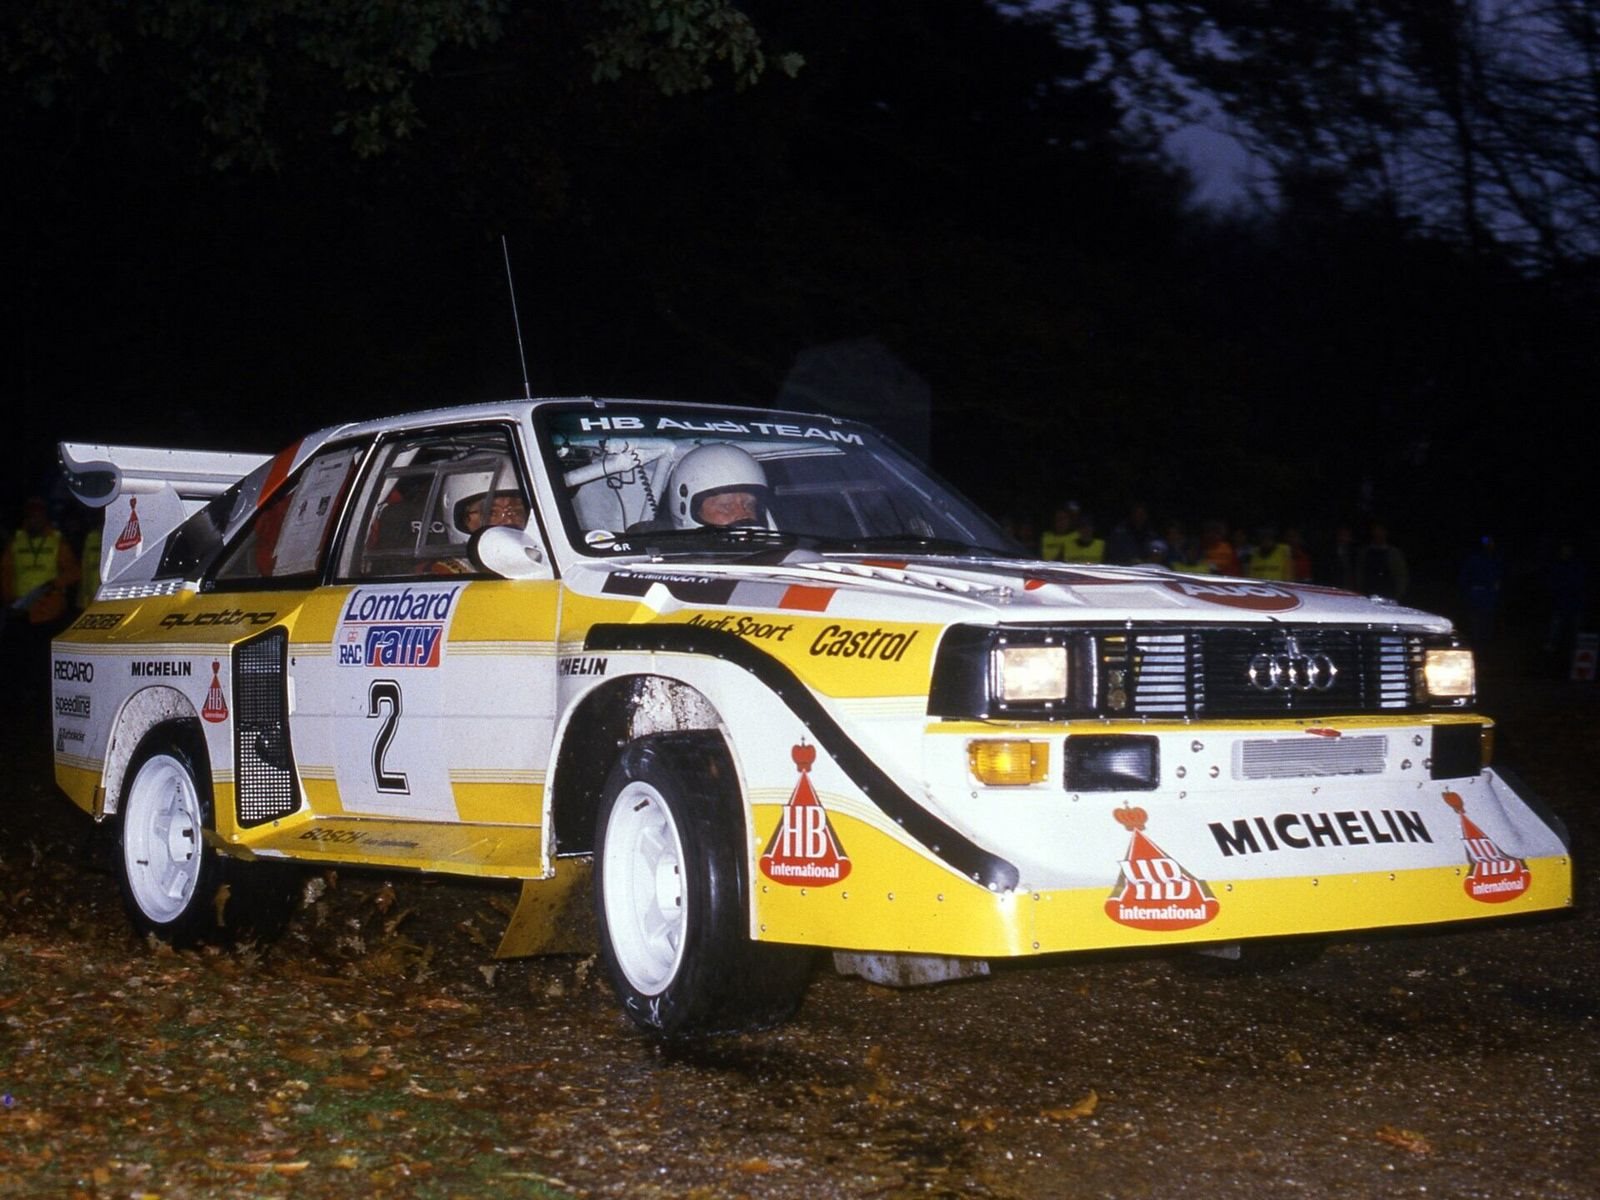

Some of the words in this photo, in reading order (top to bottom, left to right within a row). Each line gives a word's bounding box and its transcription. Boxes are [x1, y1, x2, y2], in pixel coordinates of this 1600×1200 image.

[581, 416, 645, 432] HB
[750, 422, 865, 446] TEAM
[344, 586, 460, 621] Lombard
[159, 608, 277, 631] quattro
[730, 616, 795, 641] Sport
[340, 644, 363, 665] RAC
[366, 627, 443, 666] rally
[809, 624, 919, 662] Castrol
[54, 661, 94, 683] RECARO
[131, 661, 192, 677] MICHELIN
[55, 695, 91, 715] speedline
[208, 687, 223, 710] HB
[366, 679, 410, 795] 2
[299, 827, 367, 844] BOSCH
[783, 805, 827, 858] HB
[1208, 810, 1434, 857] MICHELIN
[770, 861, 840, 879] international
[1472, 876, 1525, 896] international
[1119, 903, 1207, 920] international
